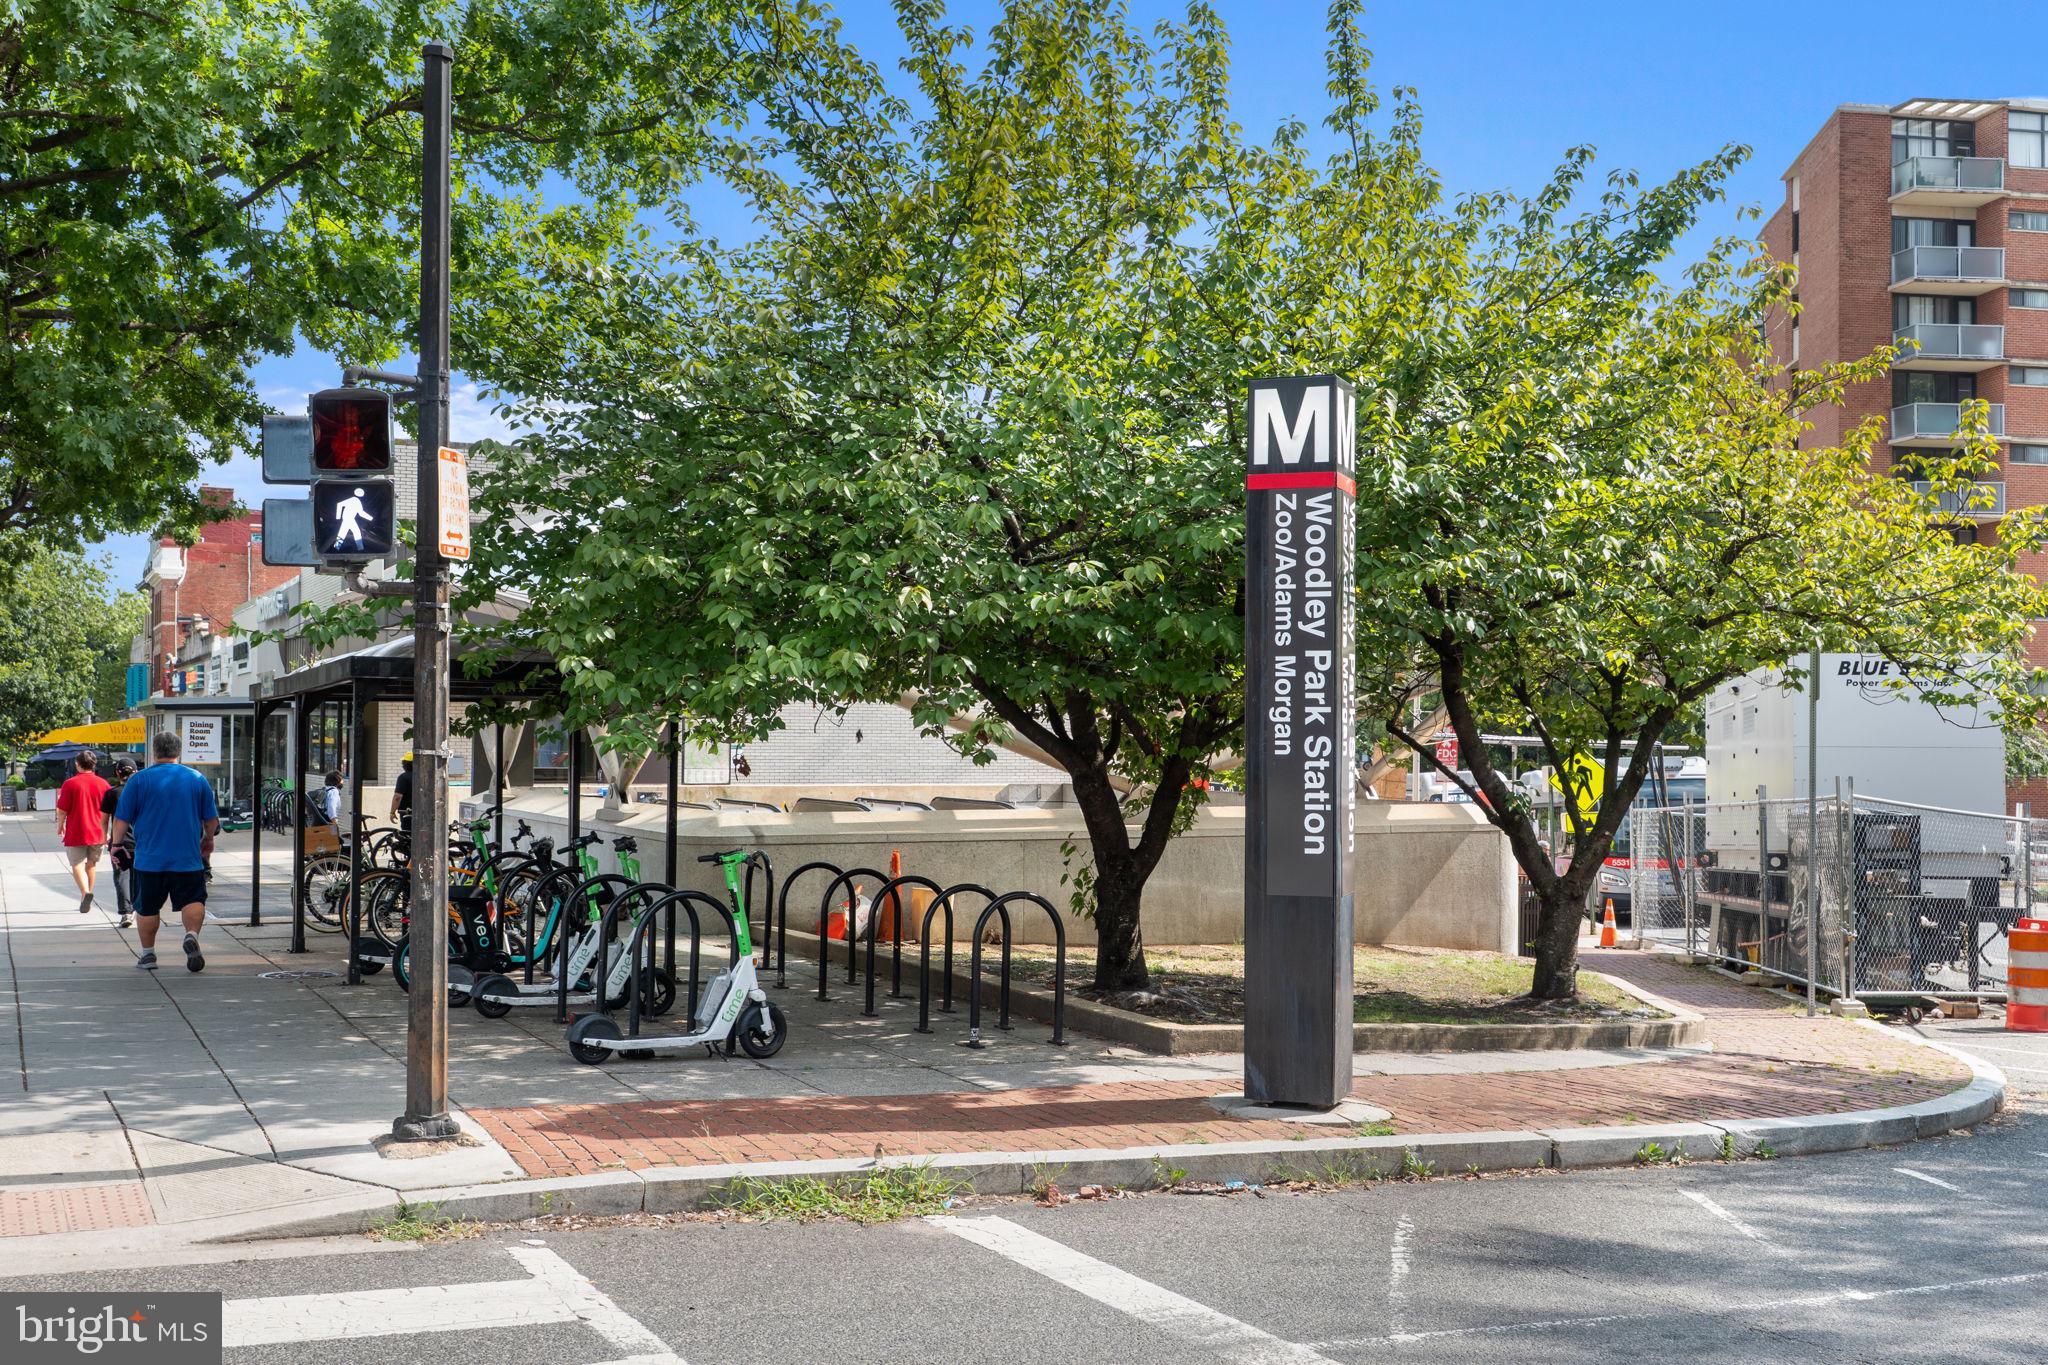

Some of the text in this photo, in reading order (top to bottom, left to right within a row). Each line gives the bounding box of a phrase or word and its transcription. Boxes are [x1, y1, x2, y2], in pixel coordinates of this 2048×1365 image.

[1253, 385, 1330, 465] M
[1337, 386, 1355, 472] M
[1269, 493, 1297, 756] Zoo/Adams Morgan
[1298, 491, 1332, 855] Woodley Park Station
[1837, 660, 1890, 676] BLUE
[1846, 678, 1880, 687] Power
[189, 721, 214, 729] Dining
[1436, 749, 1457, 758] FDC
[473, 913, 490, 948] veo
